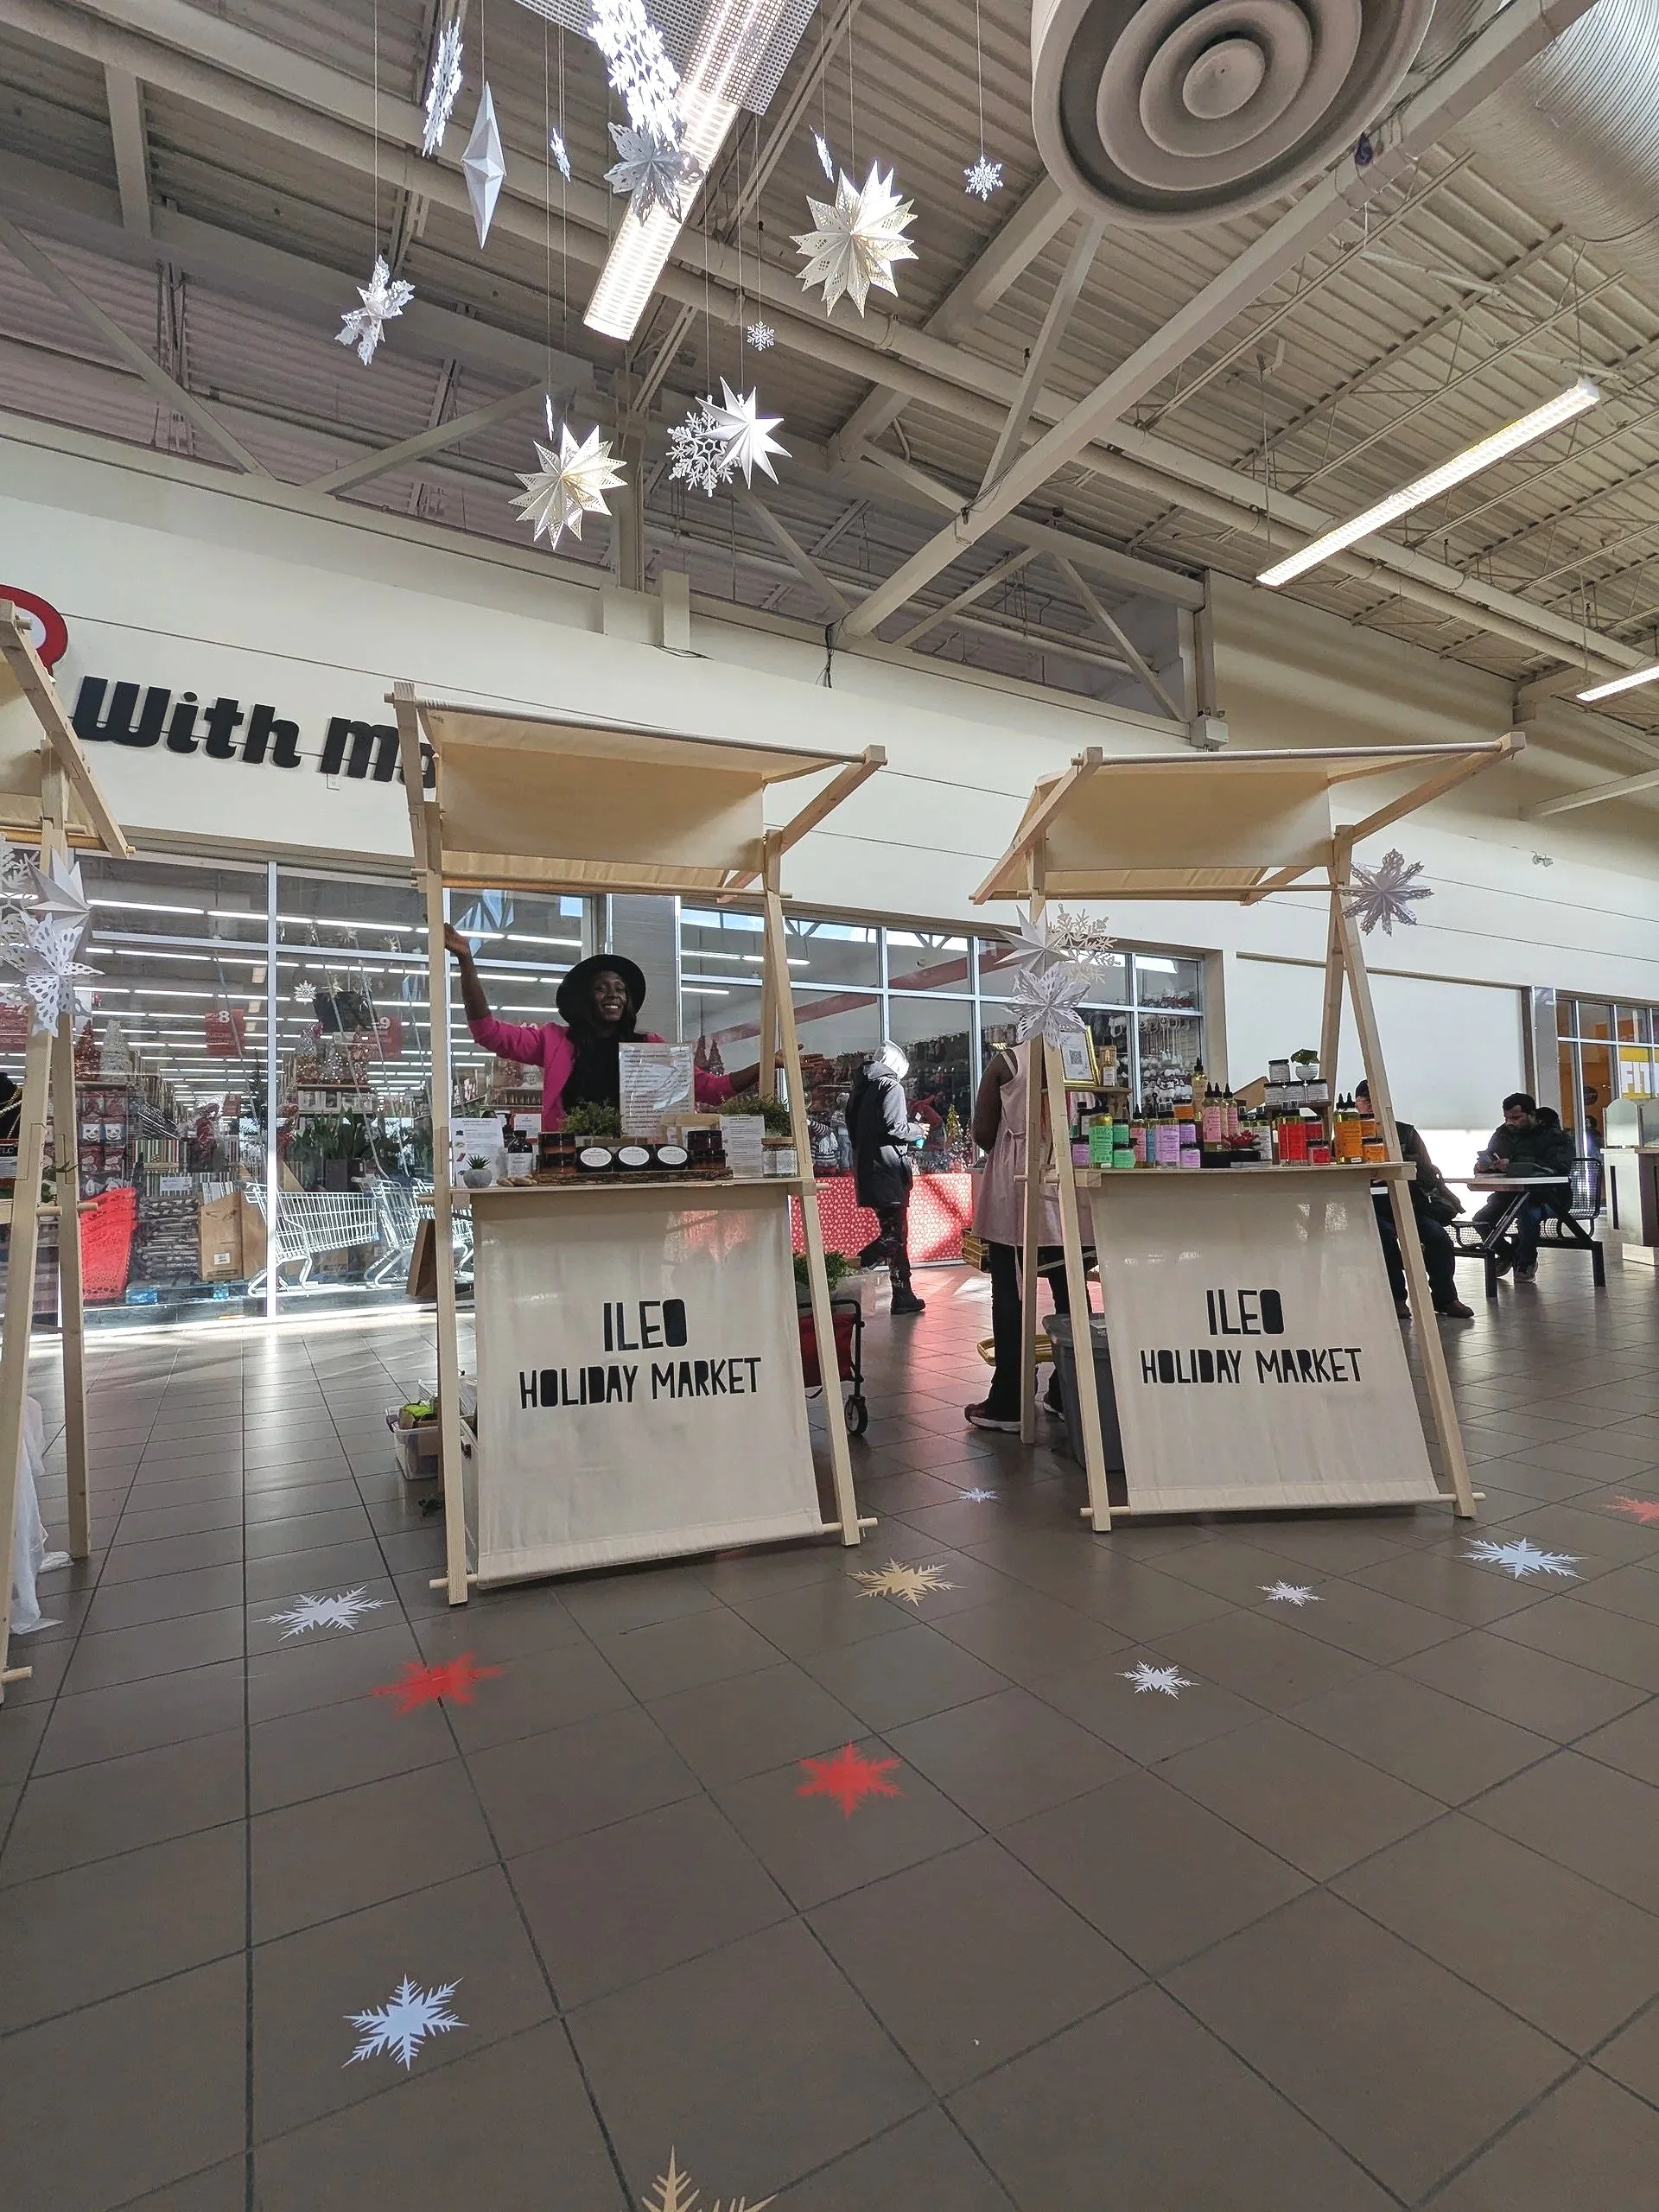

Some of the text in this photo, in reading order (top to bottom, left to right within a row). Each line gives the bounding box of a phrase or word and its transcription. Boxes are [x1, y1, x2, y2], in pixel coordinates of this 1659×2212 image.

[603, 1299, 687, 1351] ILEO
[1206, 1289, 1284, 1336] ILEO
[520, 1357, 761, 1409] HOLIDAY MARKET
[1141, 1348, 1362, 1384] HOLIDAY MARKET
